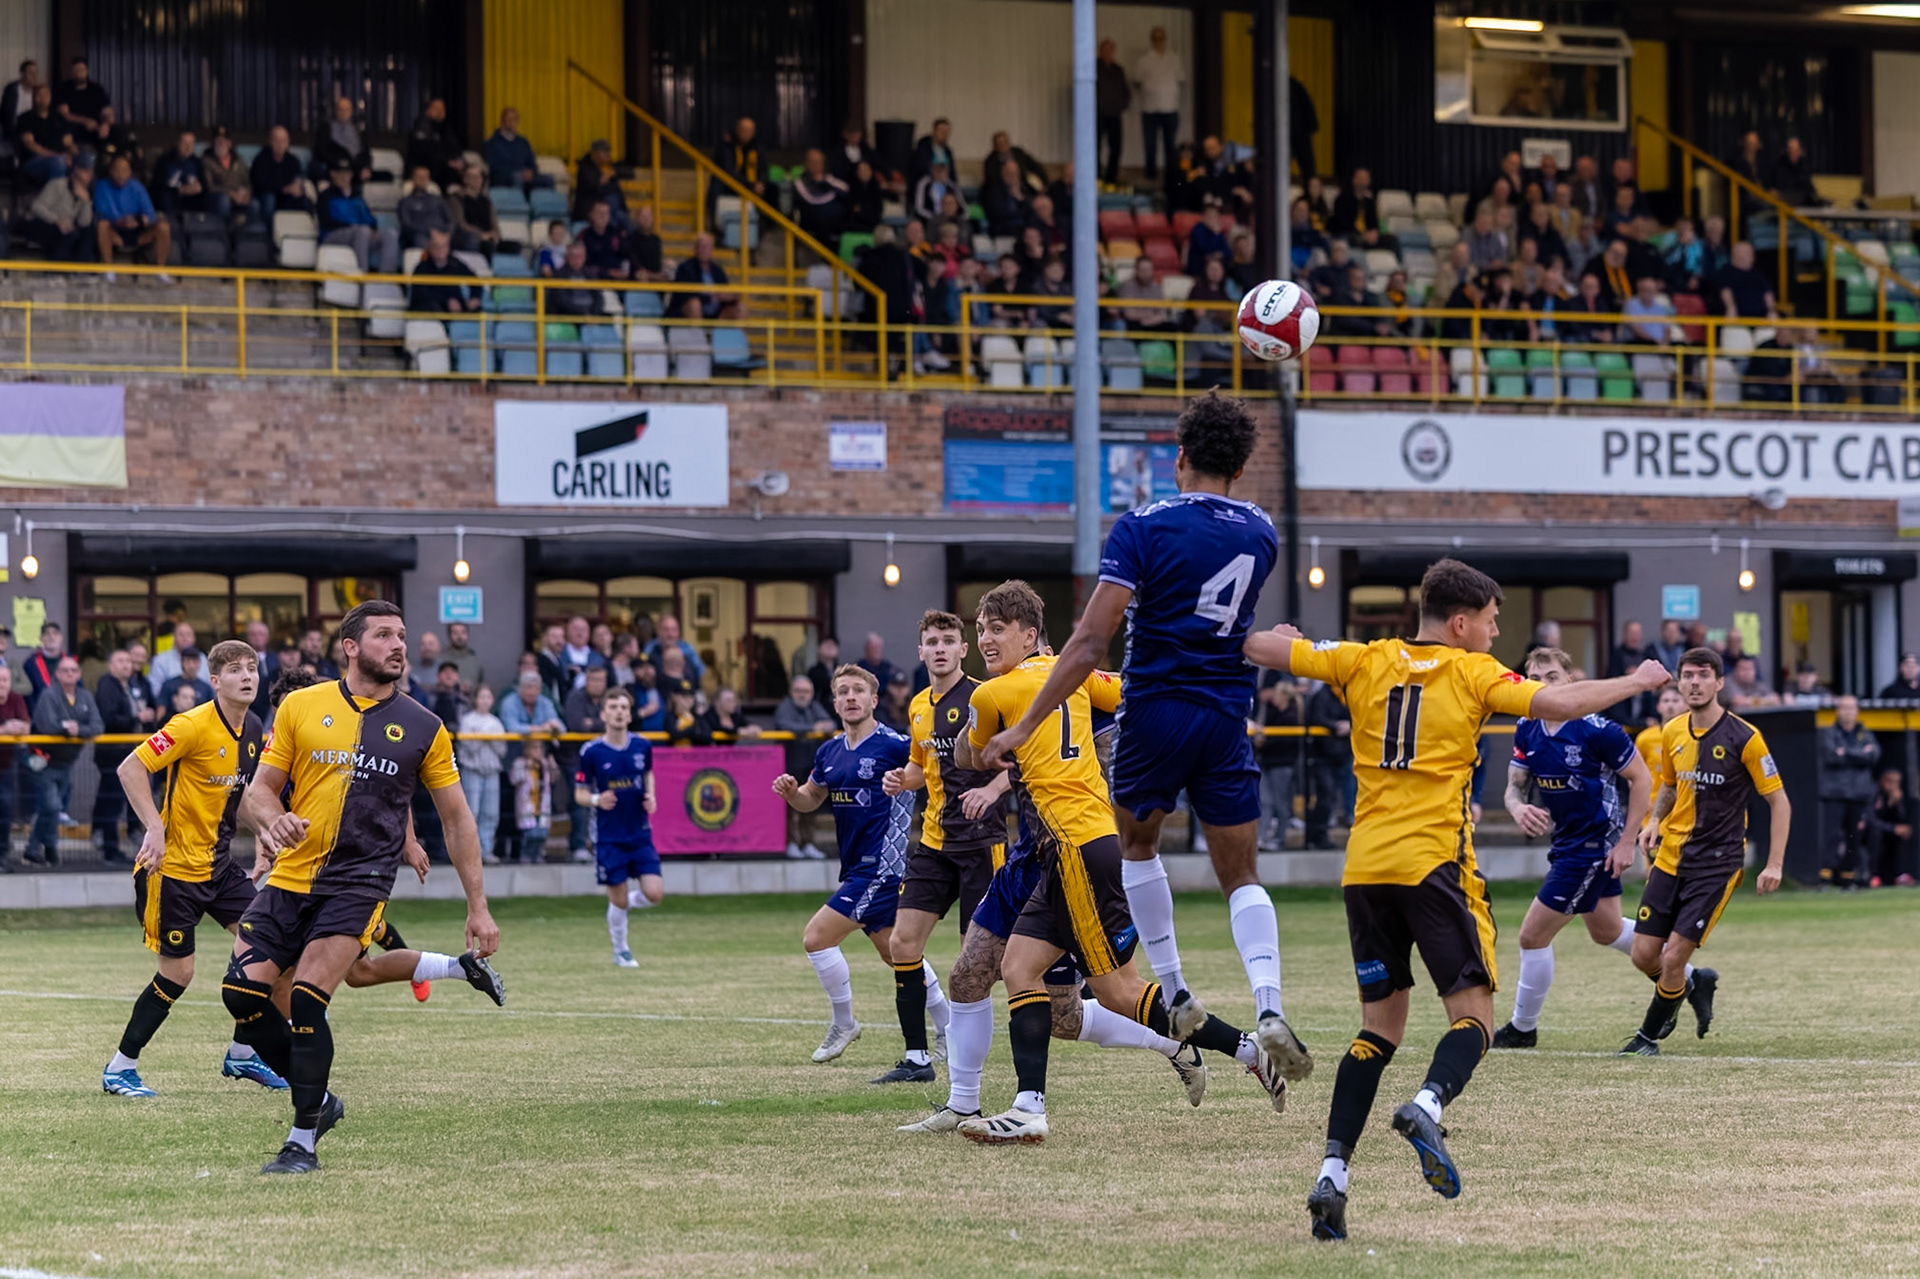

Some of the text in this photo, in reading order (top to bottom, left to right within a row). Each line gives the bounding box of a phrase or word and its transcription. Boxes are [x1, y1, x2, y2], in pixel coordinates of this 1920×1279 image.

[553, 460, 671, 498] CARLING
[1602, 429, 1920, 481] PRESCOT CAB
[1194, 553, 1256, 637] 4
[1378, 682, 1424, 770] 11
[310, 749, 399, 776] MERMAID
